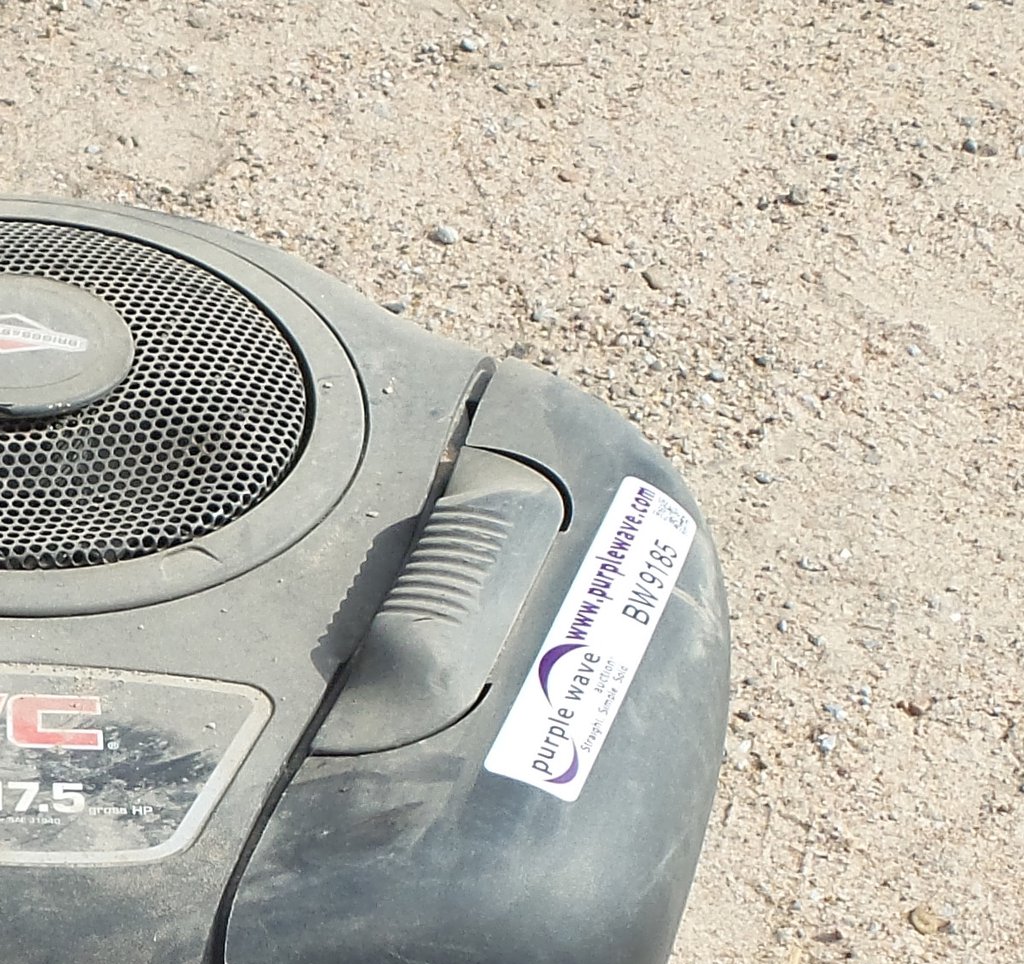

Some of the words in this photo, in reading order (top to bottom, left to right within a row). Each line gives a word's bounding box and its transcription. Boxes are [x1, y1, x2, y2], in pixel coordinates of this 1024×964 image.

[565, 486, 656, 641] www.purplewave.com
[622, 539, 678, 626] BW9185
[532, 707, 575, 775] purple
[564, 652, 601, 701] wave
[131, 804, 153, 816] HP
